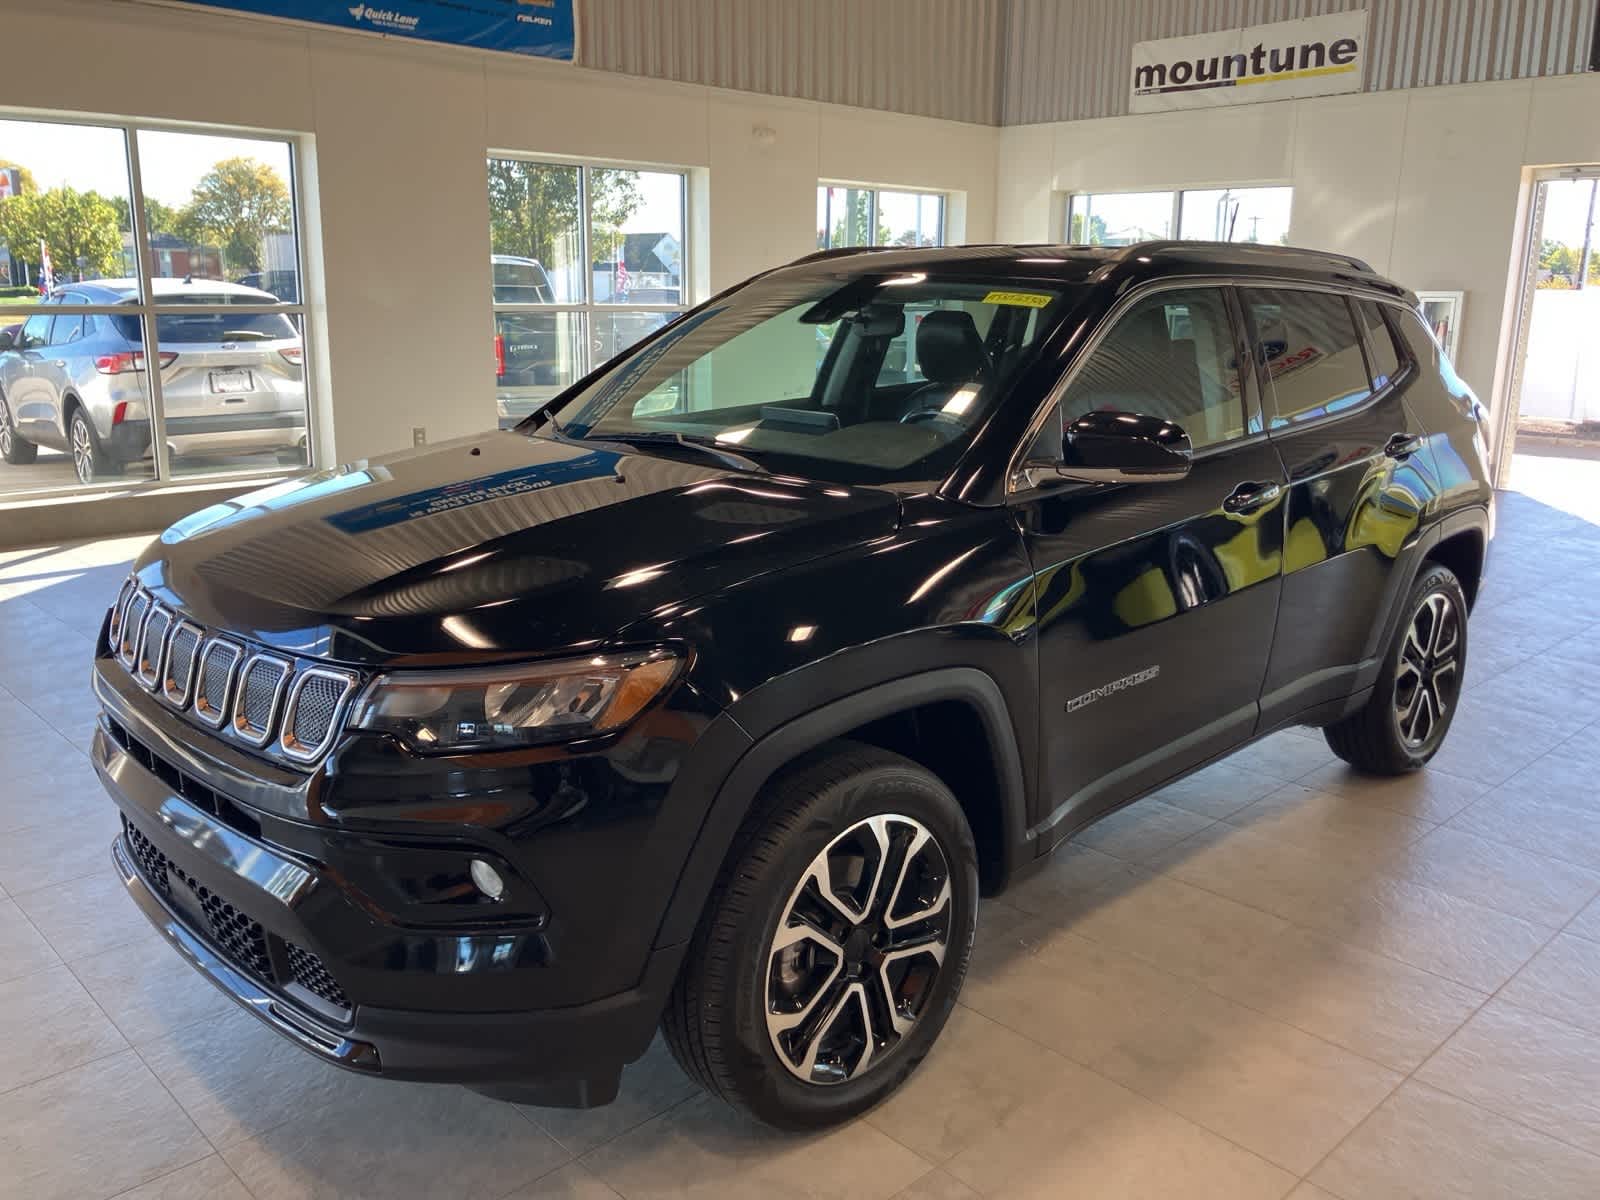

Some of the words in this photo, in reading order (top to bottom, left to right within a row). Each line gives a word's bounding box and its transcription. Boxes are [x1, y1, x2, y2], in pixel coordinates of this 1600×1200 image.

[365, 7, 393, 20] Quick
[394, 12, 419, 25] Lane
[1134, 38, 1358, 88] mountune
[1066, 664, 1160, 712] COMPASS
